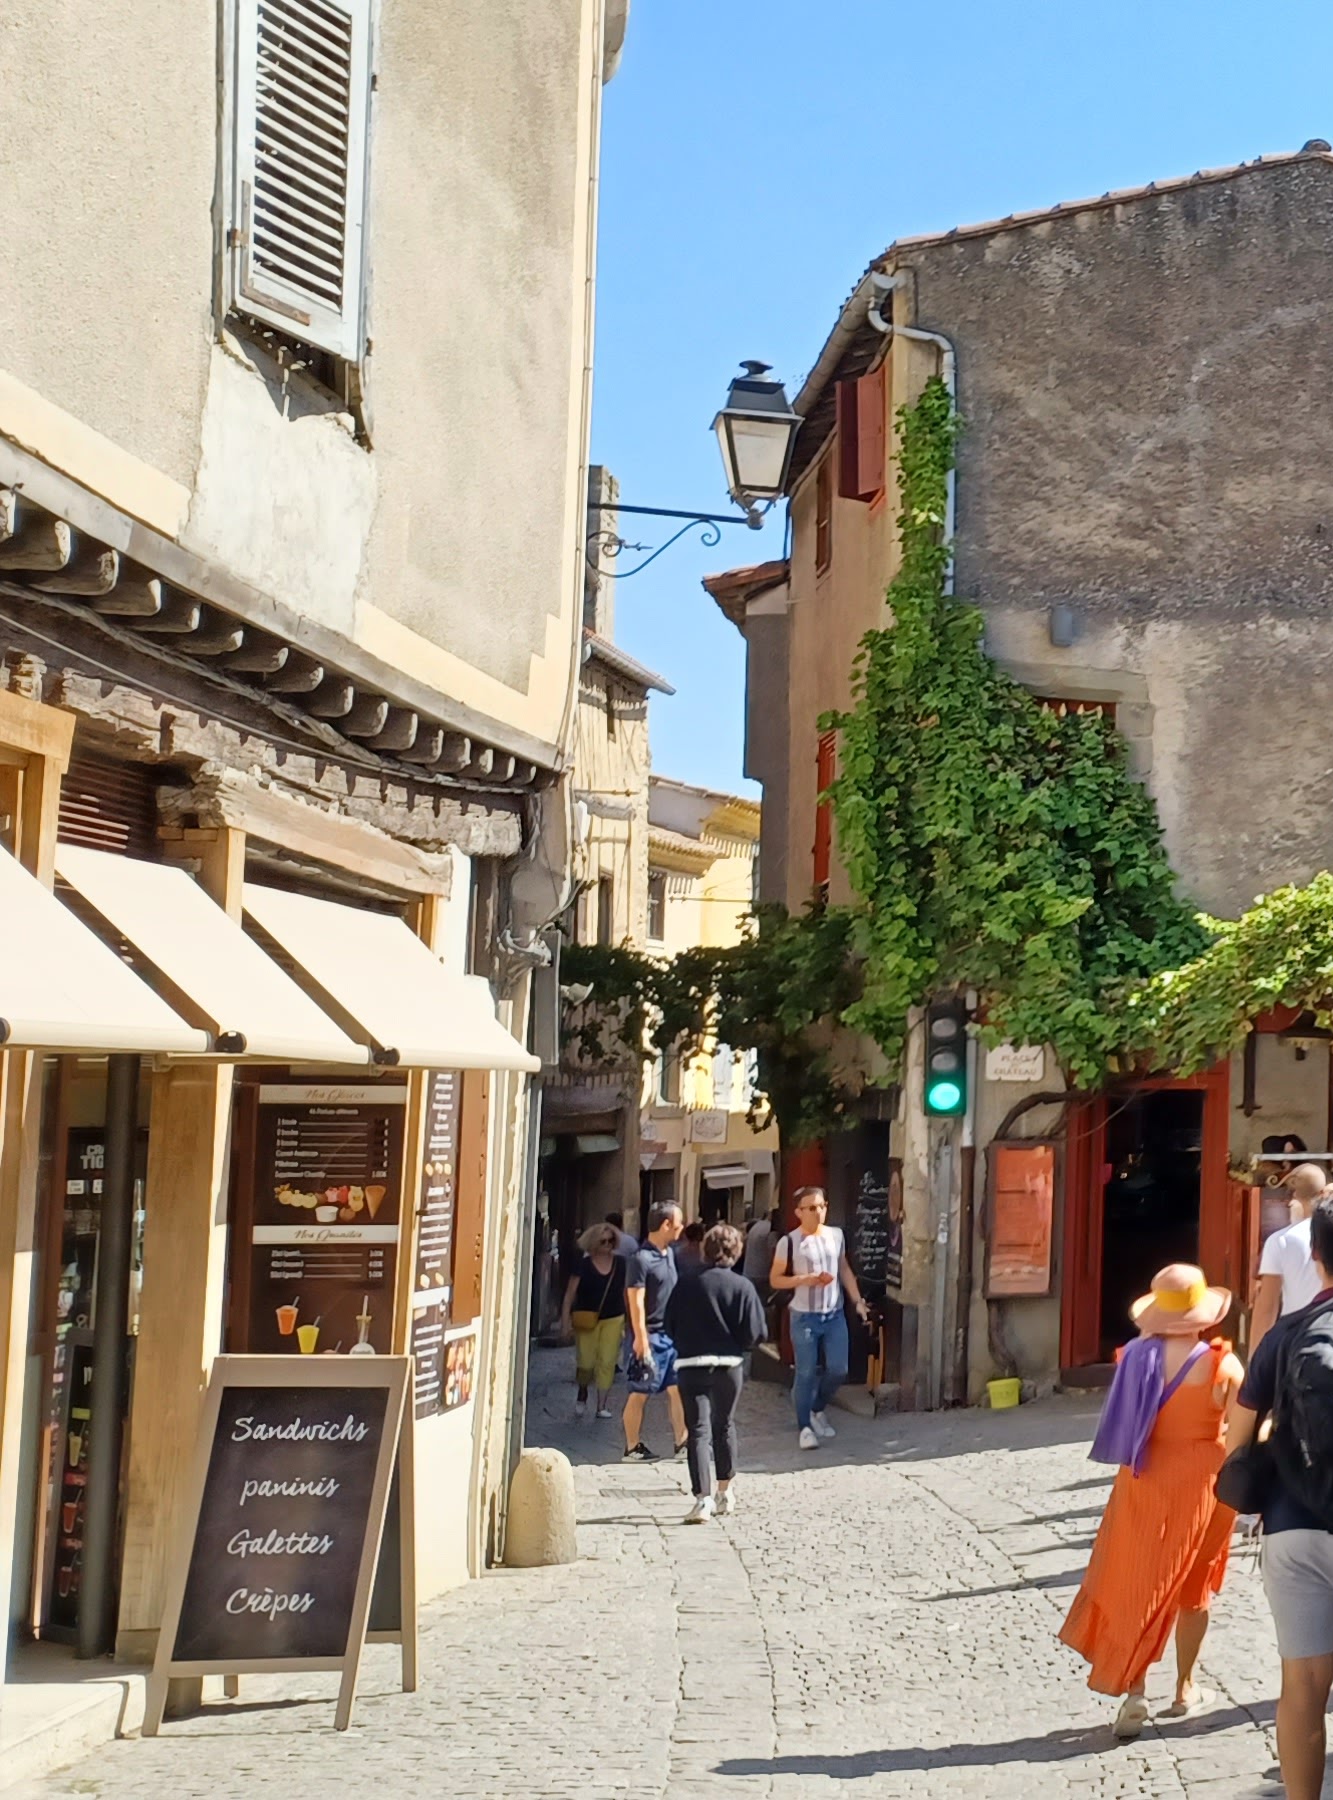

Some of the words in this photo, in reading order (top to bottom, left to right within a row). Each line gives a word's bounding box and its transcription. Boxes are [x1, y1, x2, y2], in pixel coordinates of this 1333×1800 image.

[231, 1414, 369, 1442] Sandwichs
[239, 1477, 341, 1506] paninis
[226, 1528, 334, 1558] Galettes
